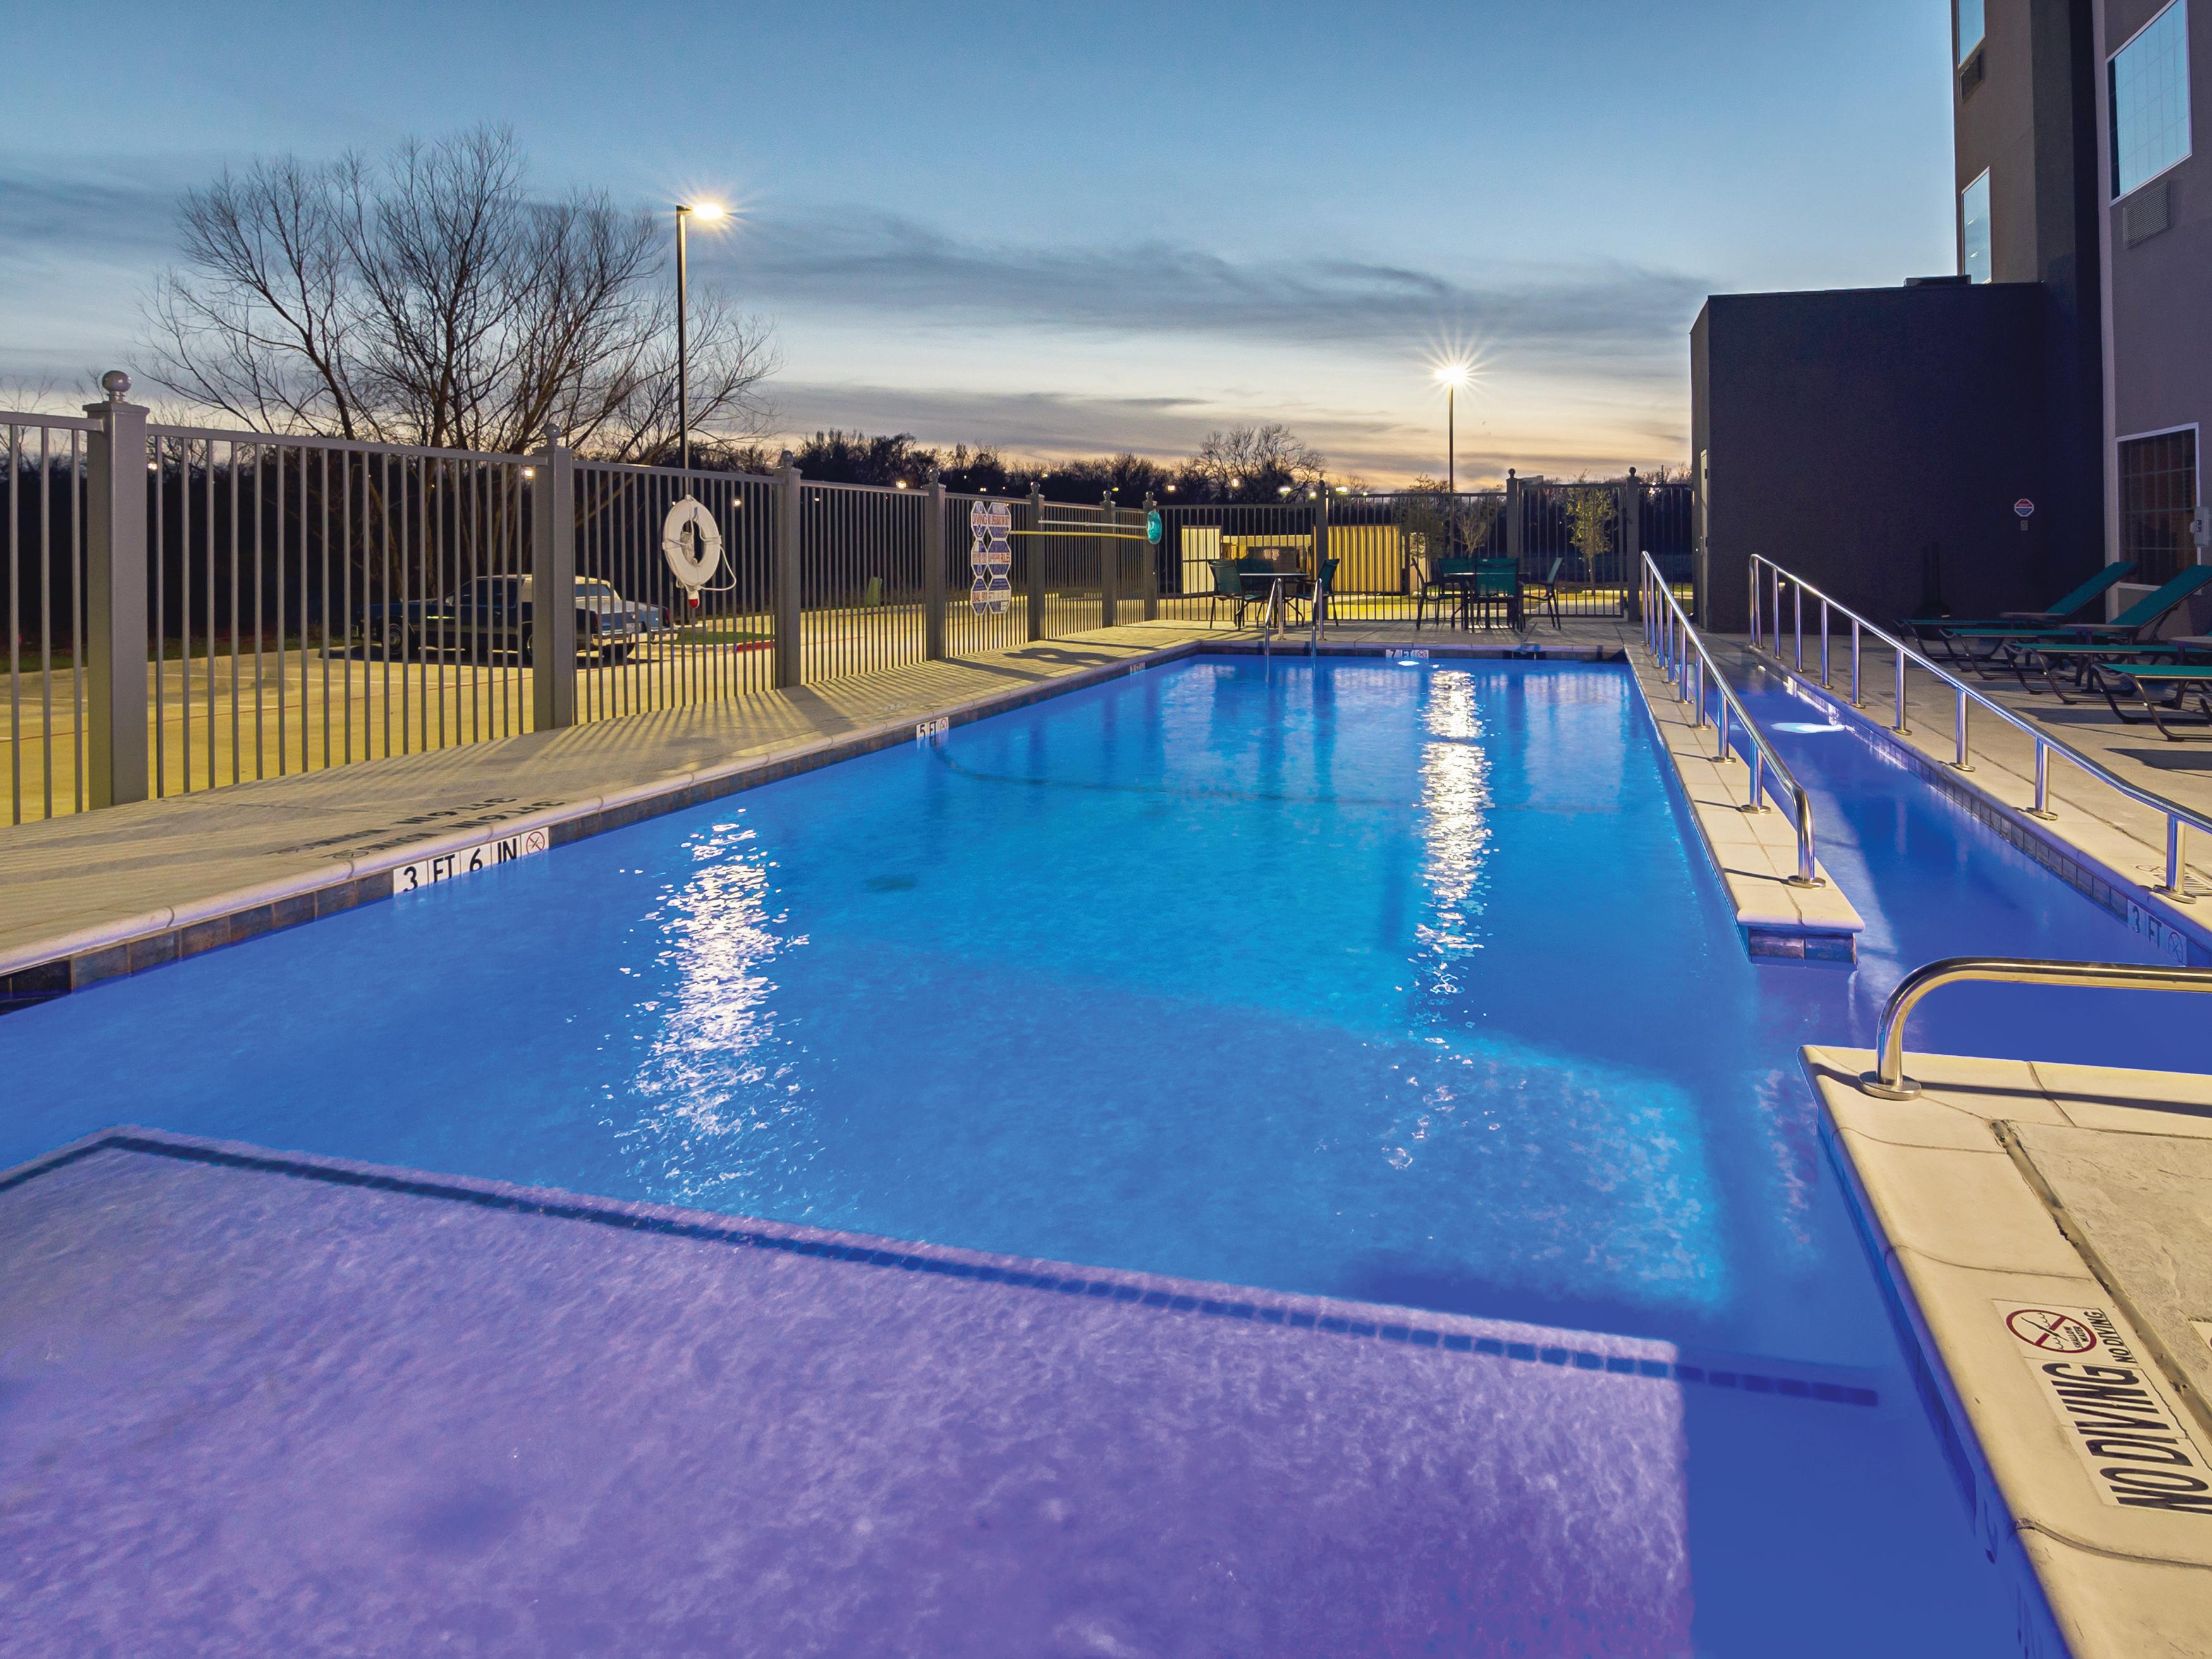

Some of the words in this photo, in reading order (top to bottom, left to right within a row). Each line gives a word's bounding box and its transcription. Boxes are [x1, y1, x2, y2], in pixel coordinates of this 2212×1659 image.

[972, 513, 987, 525] DIVING
[920, 724, 926, 738] 5
[929, 721, 937, 735] FT
[403, 866, 419, 892] 3
[433, 854, 455, 883] FT
[469, 847, 484, 872] 6
[498, 838, 517, 864] IN
[2132, 905, 2140, 933] 3
[2148, 914, 2162, 947] FT
[2084, 1311, 2125, 1347] DIVING
[2108, 1347, 2139, 1364] NO
[2042, 1363, 2194, 1467] DIVING
[2099, 1467, 2212, 1515] NO
